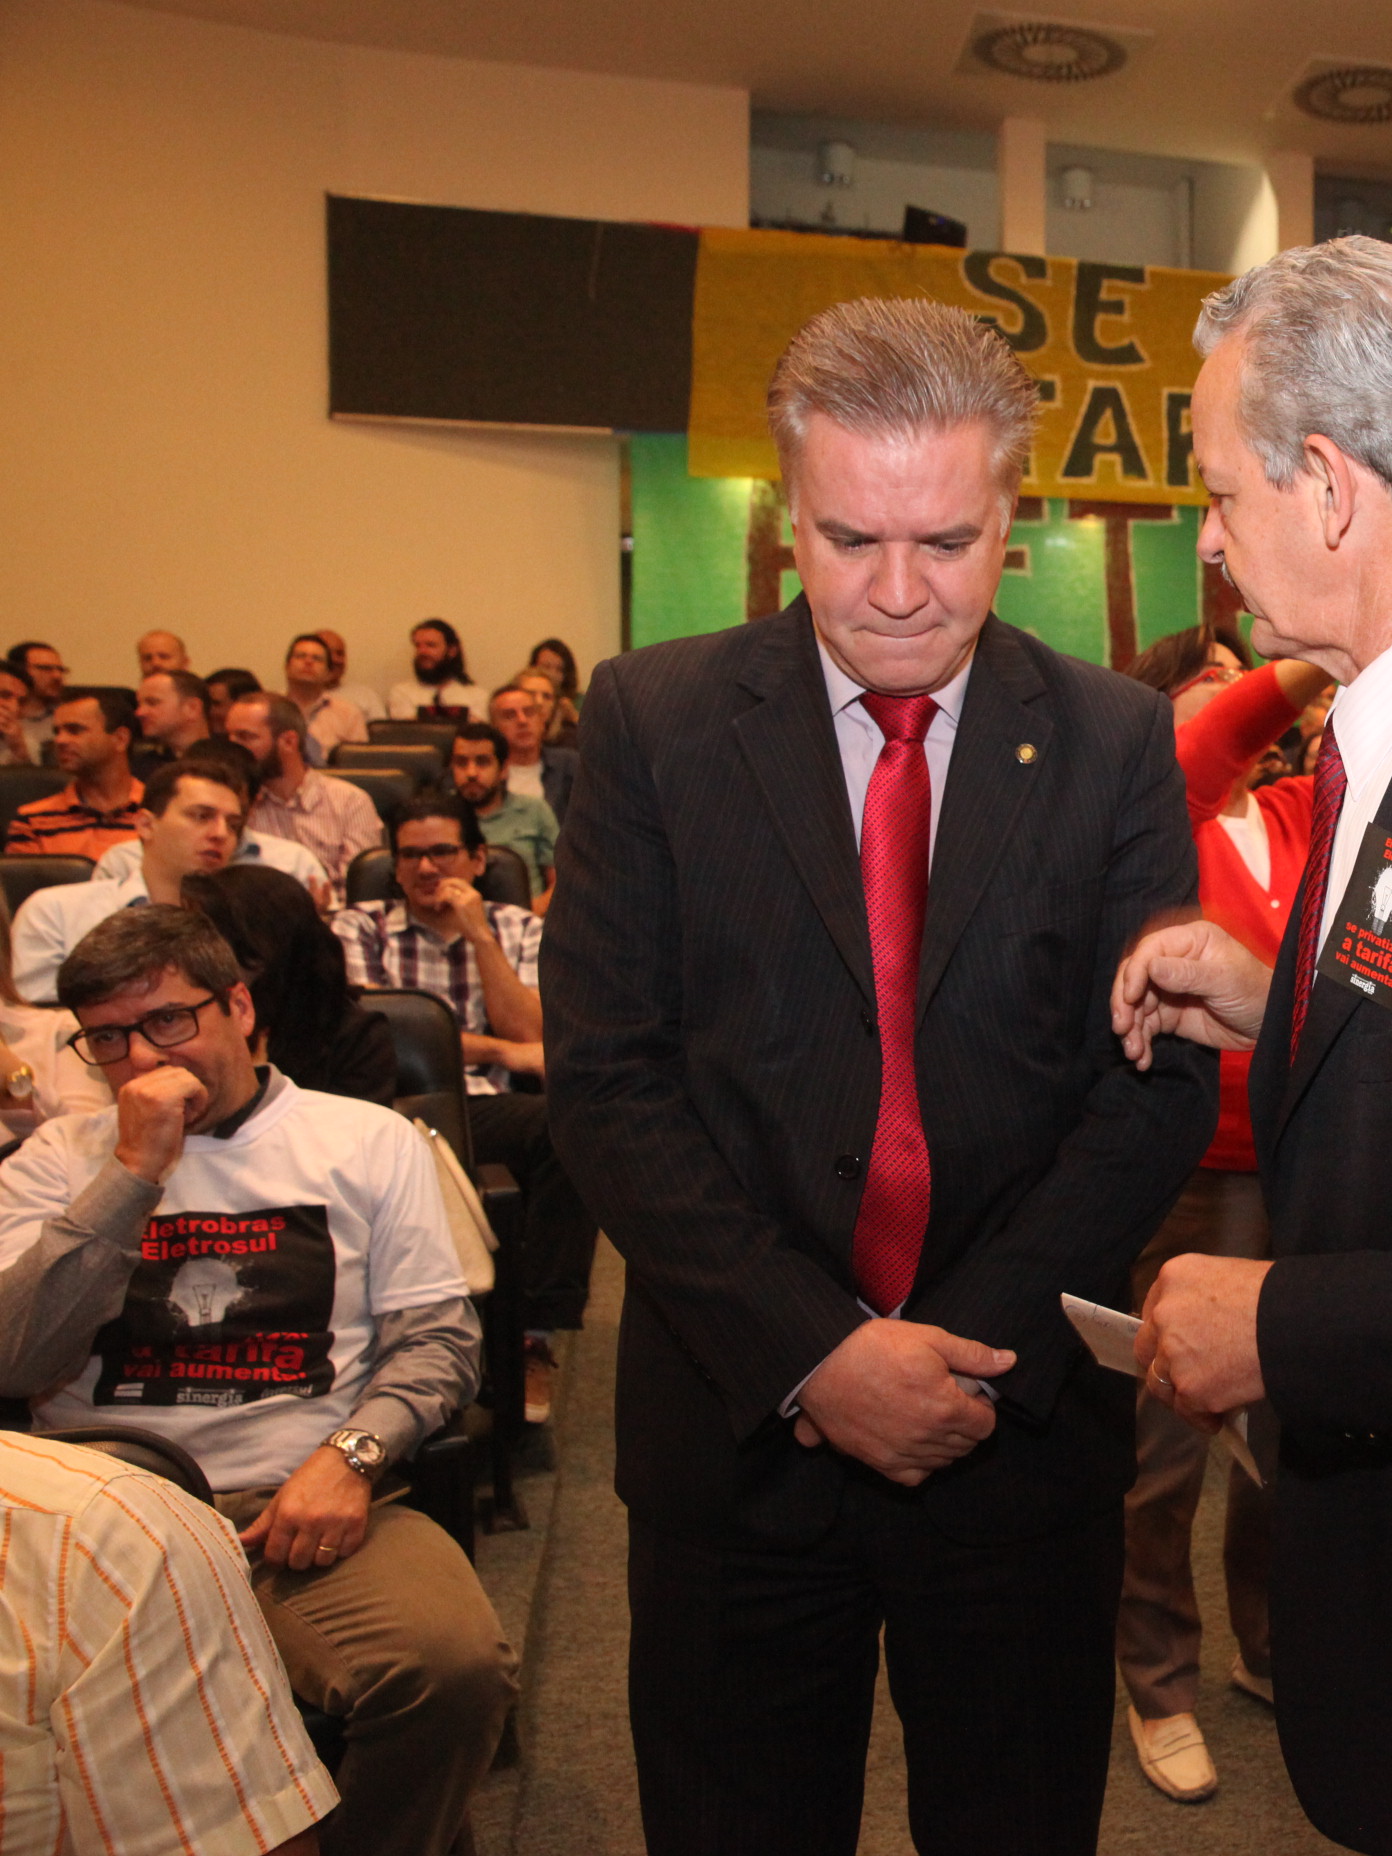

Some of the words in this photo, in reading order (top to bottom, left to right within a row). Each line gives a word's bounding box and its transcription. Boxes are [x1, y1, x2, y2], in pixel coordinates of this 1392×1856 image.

[960, 250, 1148, 367] SE
[1345, 922, 1358, 933] se
[1342, 937, 1353, 951] a
[1335, 951, 1350, 965] vai
[1350, 975, 1376, 994] sinergia
[141, 1232, 278, 1261] Eletrosul
[123, 1361, 162, 1378] vai
